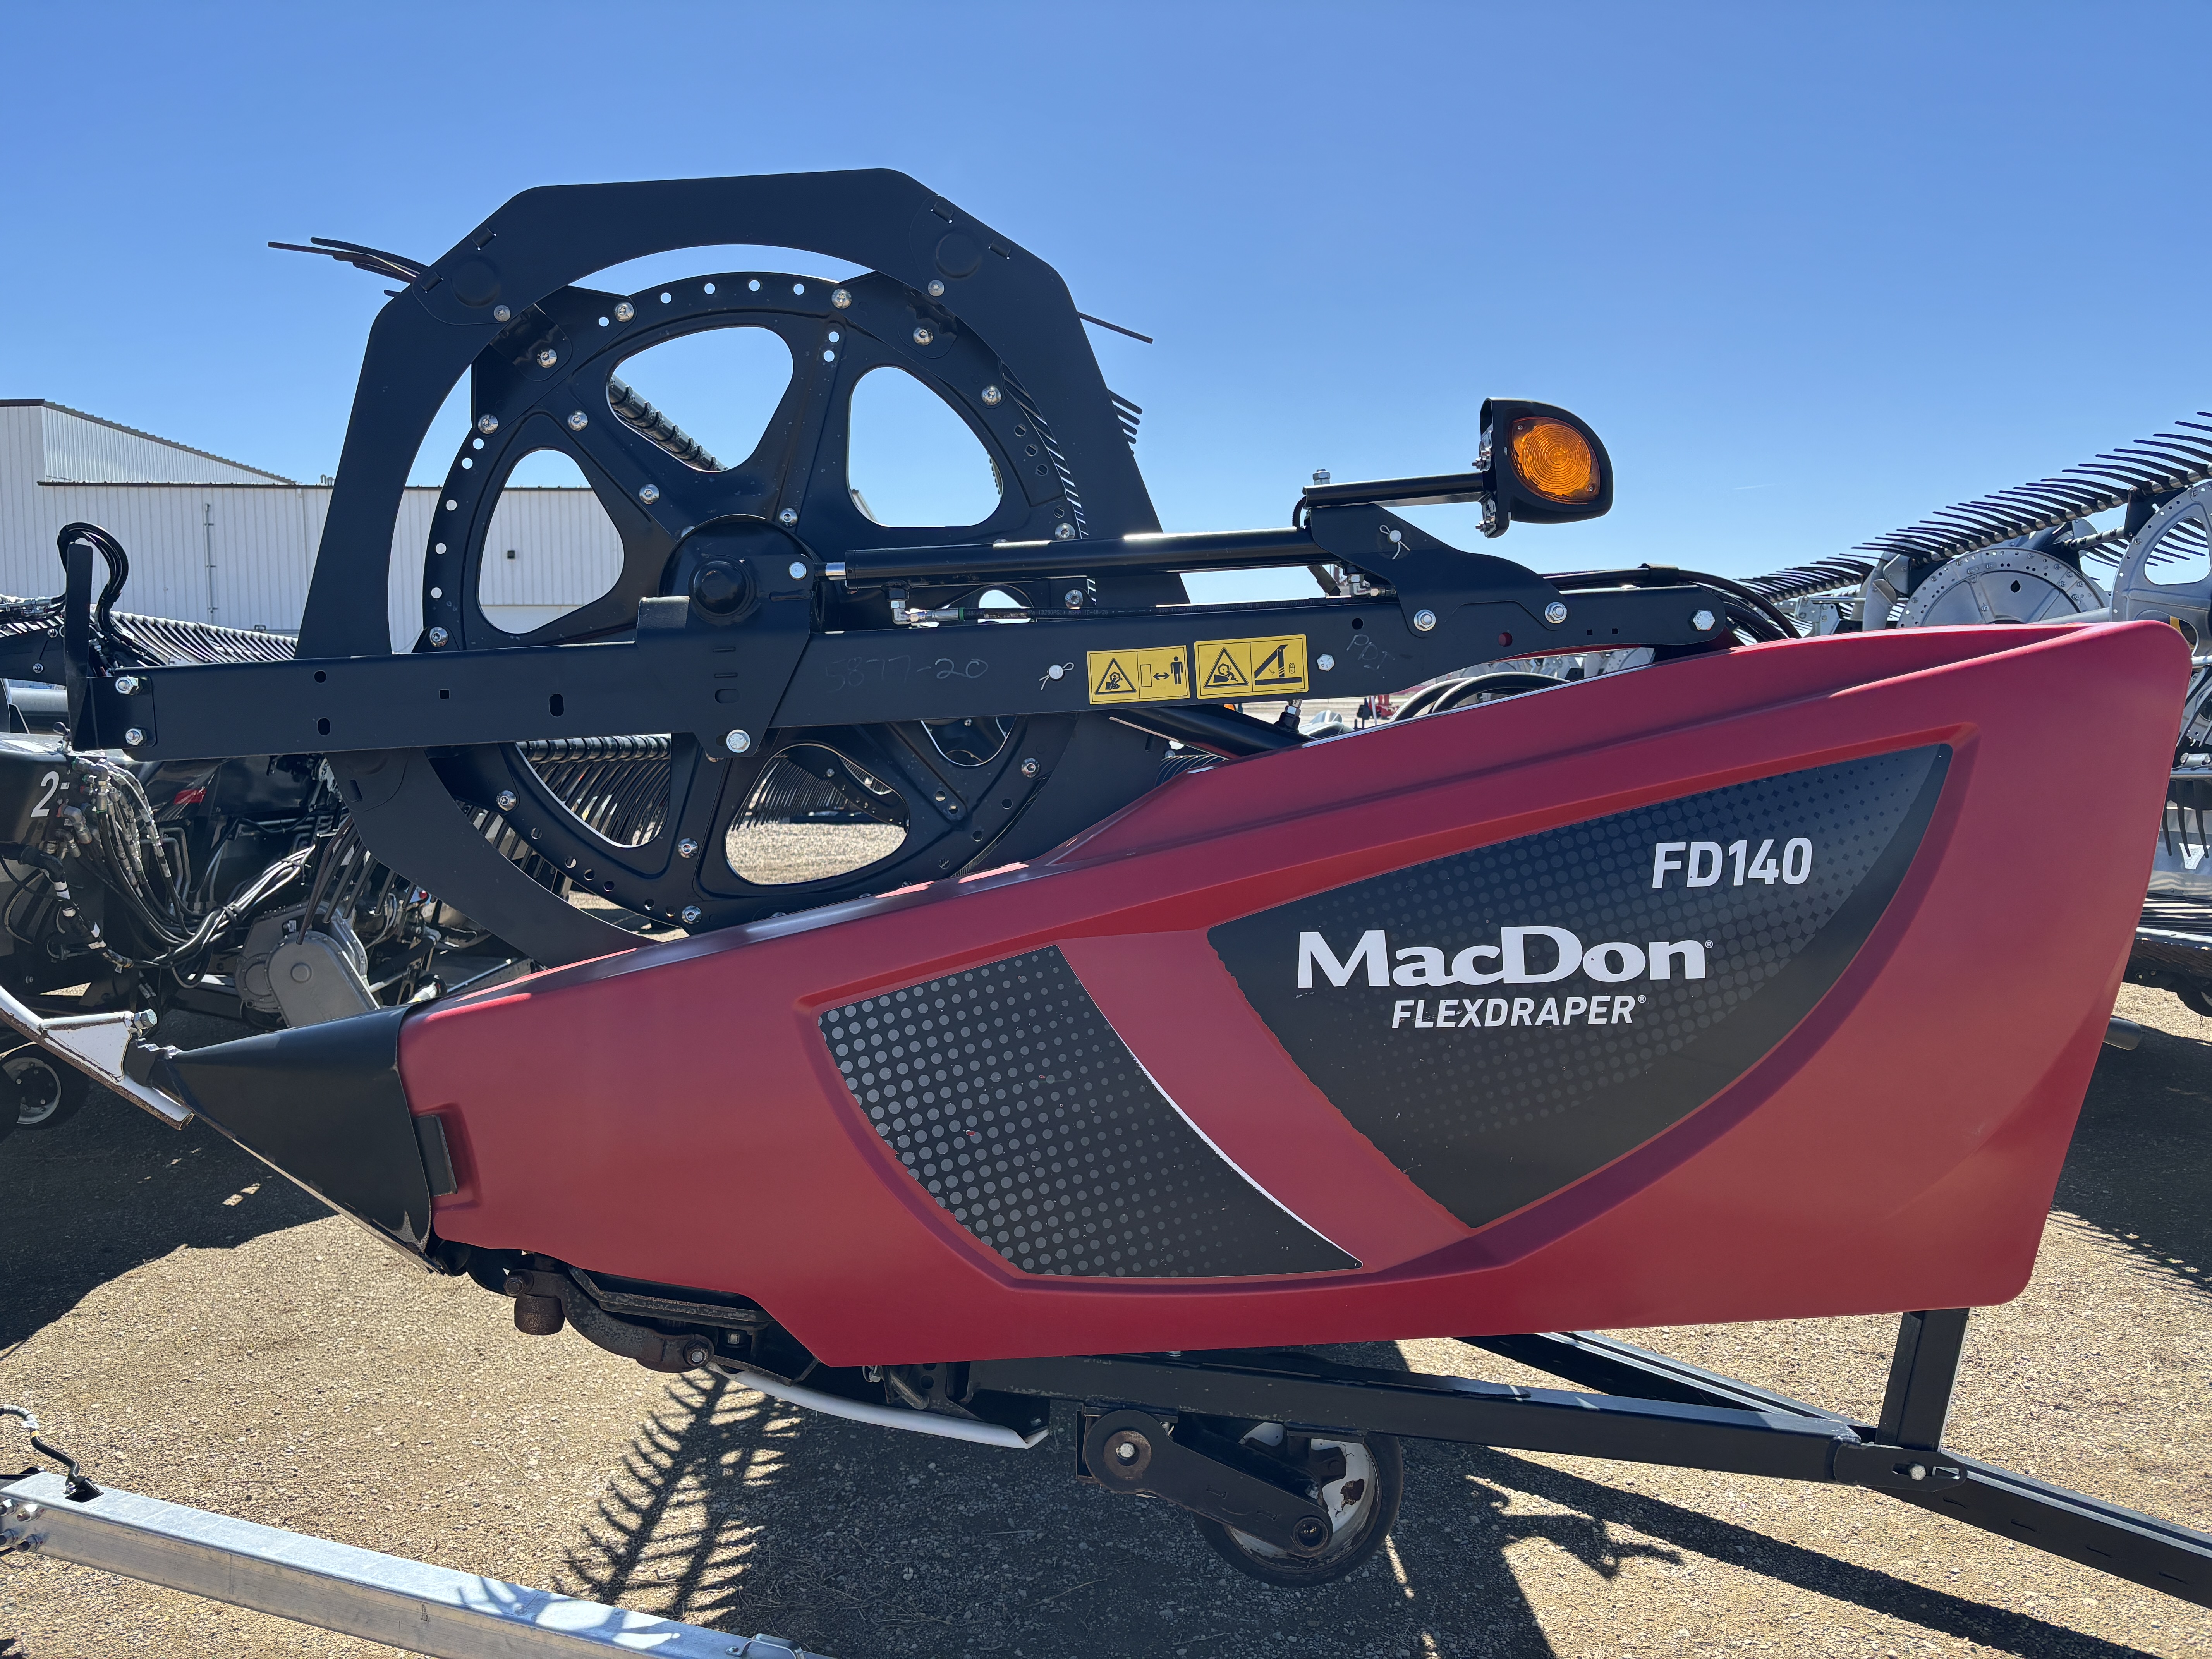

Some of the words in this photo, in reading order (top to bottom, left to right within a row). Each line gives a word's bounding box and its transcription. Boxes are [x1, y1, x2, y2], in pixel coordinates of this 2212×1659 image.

[825, 655, 989, 692] 5877-20
[31, 771, 60, 817] 2
[1651, 837, 1813, 888] FD140
